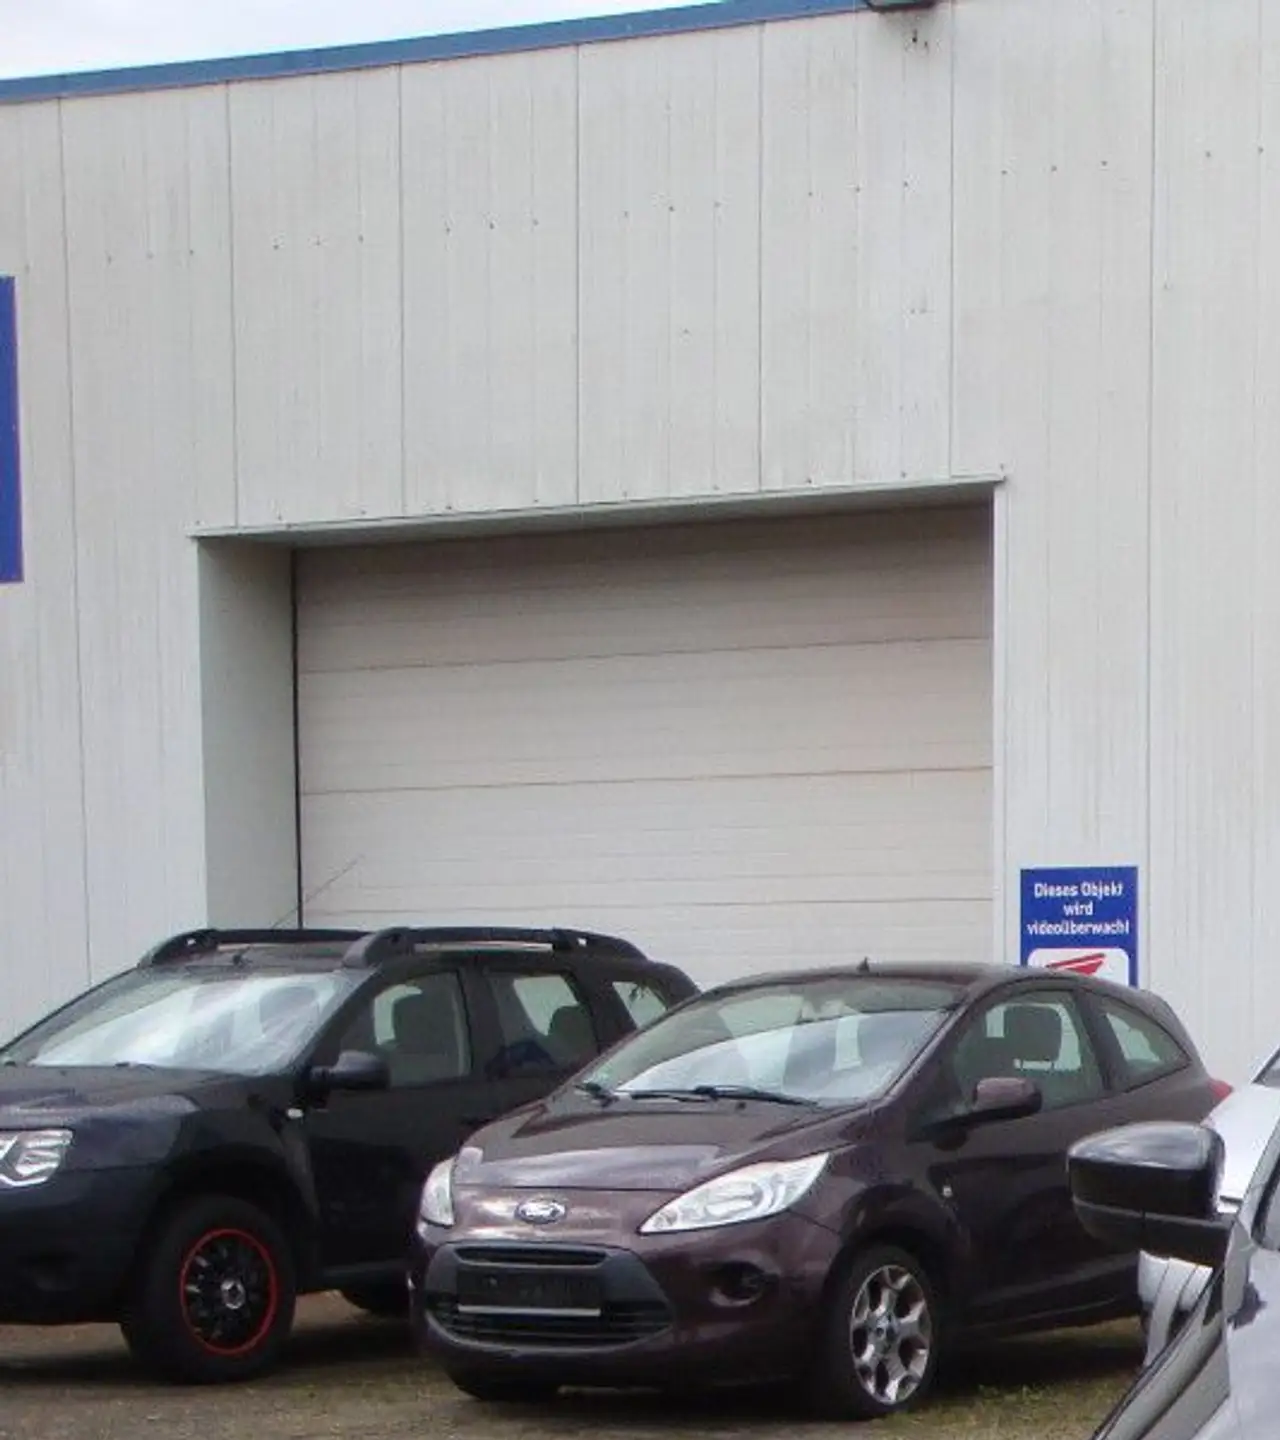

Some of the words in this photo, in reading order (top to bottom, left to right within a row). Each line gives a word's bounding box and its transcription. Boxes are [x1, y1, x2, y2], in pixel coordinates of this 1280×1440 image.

[1034, 883, 1079, 897] Dieses
[1081, 882, 1122, 899] Objekt
[1063, 901, 1093, 916] wird
[1027, 920, 1129, 935] videoüberwacht
